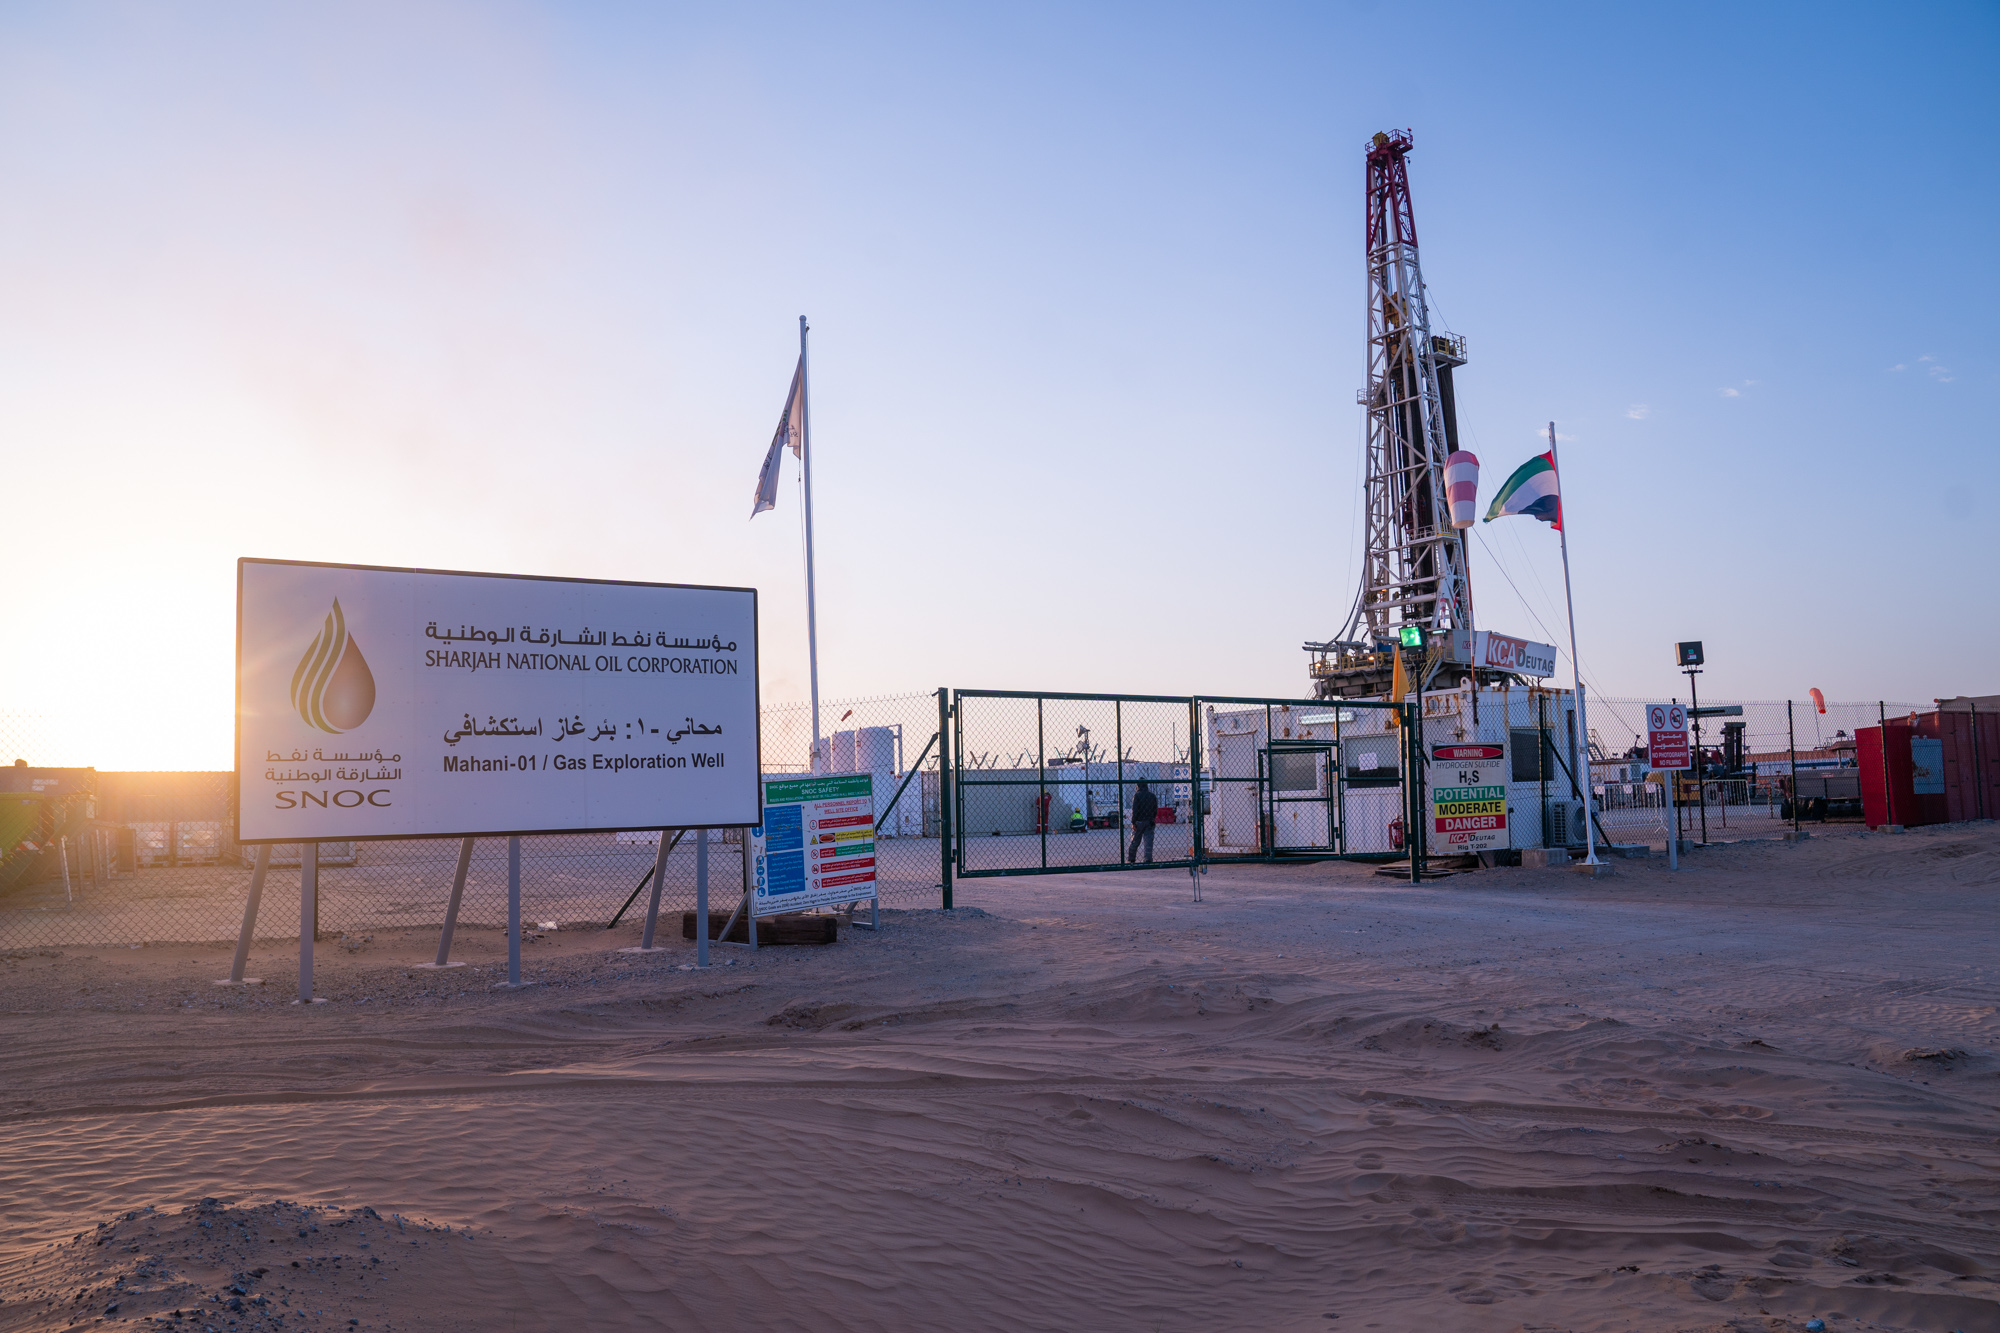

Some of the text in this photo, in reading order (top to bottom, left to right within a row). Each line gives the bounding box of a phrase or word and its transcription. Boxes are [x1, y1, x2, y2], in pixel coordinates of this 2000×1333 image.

[425, 621, 737, 653] مؤسسة نفط الشارقة الوطنية
[1488, 638, 1516, 665] KCA
[425, 650, 738, 675] SHARJAH NATIONAL OIL CORPORATION
[443, 713, 542, 747] استكشافي
[551, 715, 585, 742] غاز
[587, 718, 616, 741] بئر
[666, 717, 722, 745] محاني
[1656, 732, 1682, 742] ممنوع
[265, 748, 401, 763] مؤسسة نفط
[443, 753, 724, 773] Mahani-01 / Gas Exploration Well
[1452, 749, 1483, 758] WARNING
[1436, 760, 1501, 769] HYDROGEN SULFIDE
[265, 765, 402, 785] الشارقة الوطنية
[275, 789, 392, 809] SNOC
[818, 786, 840, 794] SAFETY
[1435, 787, 1504, 801] POTENTIAL
[1438, 801, 1502, 815] MODERATE
[1445, 816, 1497, 831] DANGER
[1450, 833, 1470, 843] KCA
